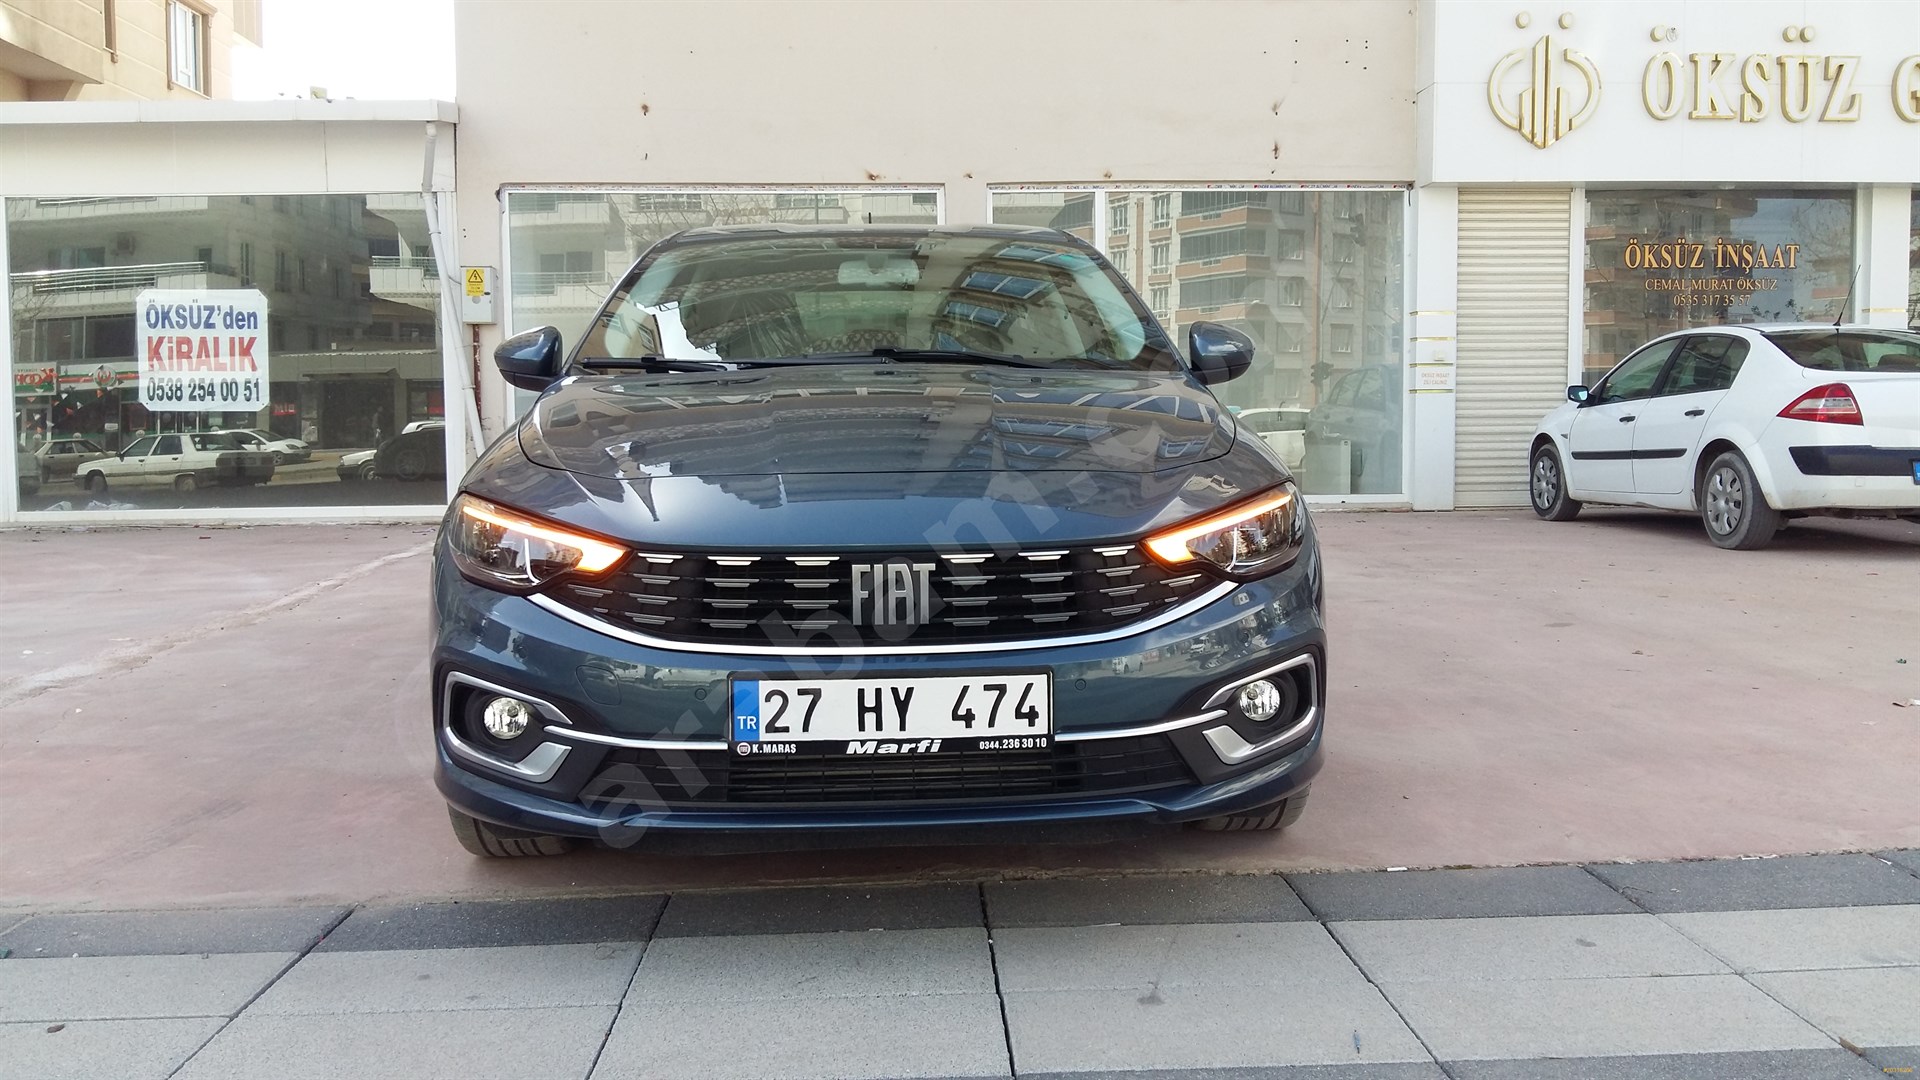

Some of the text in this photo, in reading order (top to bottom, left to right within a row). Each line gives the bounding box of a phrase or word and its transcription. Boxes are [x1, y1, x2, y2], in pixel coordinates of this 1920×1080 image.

[1642, 24, 1863, 124] ÖKSÜZ
[1624, 237, 1801, 273] ÖKSÜZ İNŞAAT
[1645, 276, 1778, 291] CEMAL MURAT ÖKSÜZ
[1673, 294, 1751, 306] 0535 317 35 57
[147, 377, 260, 402] 0538 254 00 51
[851, 563, 936, 626] FIAT
[737, 682, 1040, 733] TR 27 HY 474
[846, 738, 942, 755] Marfi
[1021, 737, 1034, 749] 30
[1036, 737, 1047, 749] 10
